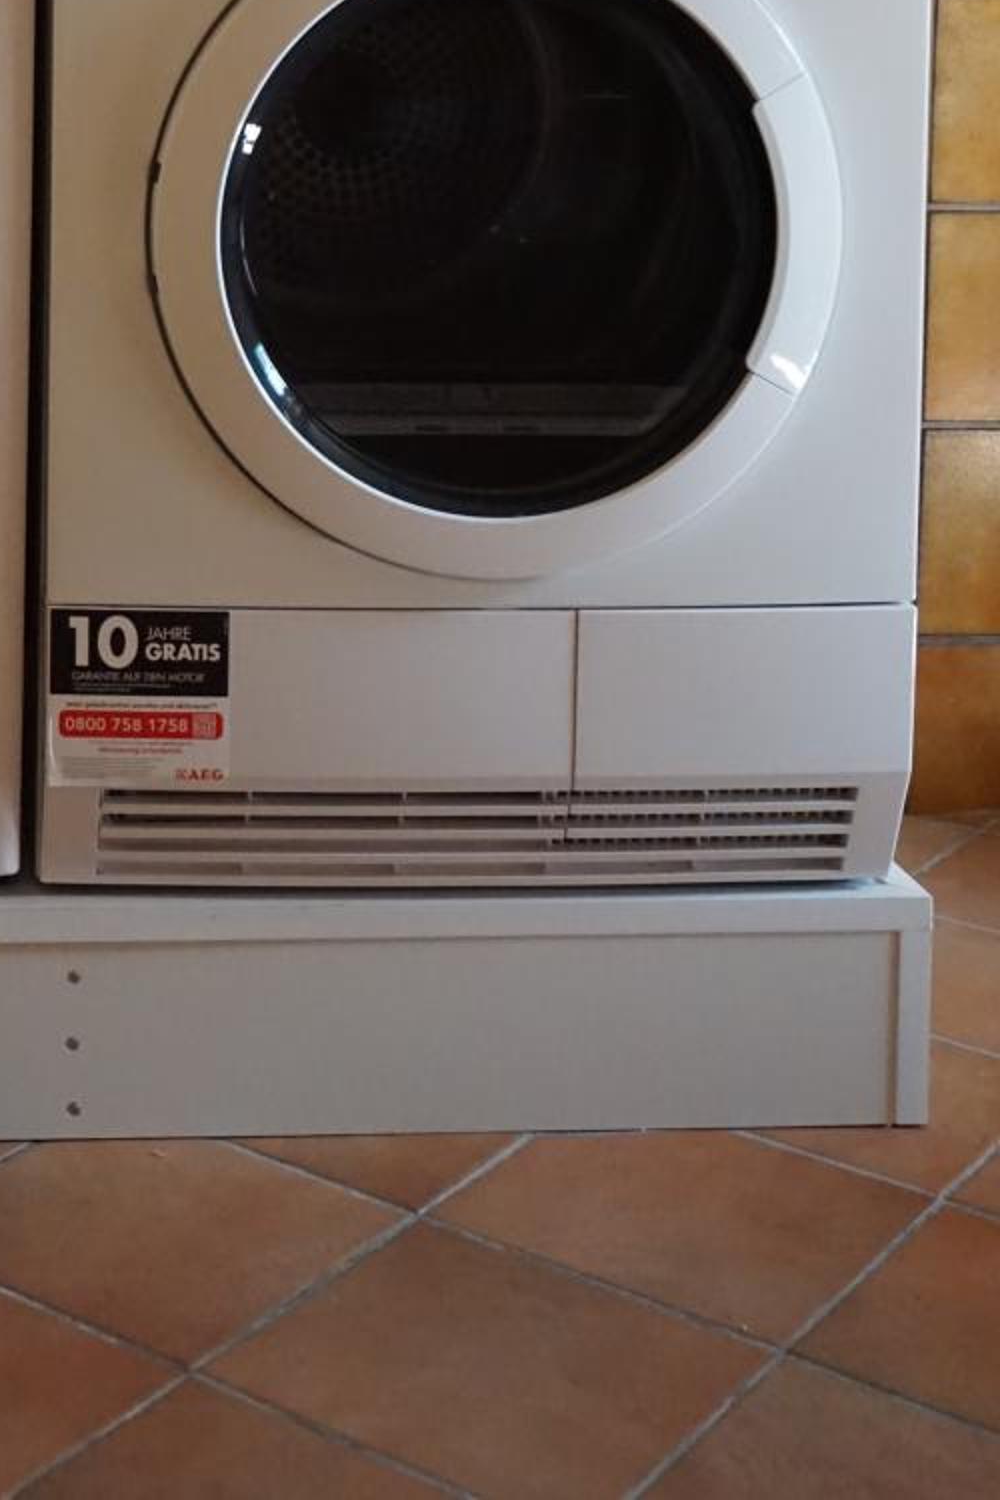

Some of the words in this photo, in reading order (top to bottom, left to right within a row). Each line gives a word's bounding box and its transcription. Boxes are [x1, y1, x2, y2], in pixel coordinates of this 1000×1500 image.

[68, 614, 139, 669] 10
[147, 626, 191, 641] JAHRE
[145, 643, 222, 662] GRATIS
[64, 717, 106, 731] 0800
[111, 717, 142, 732] 758
[149, 718, 188, 733] 1758
